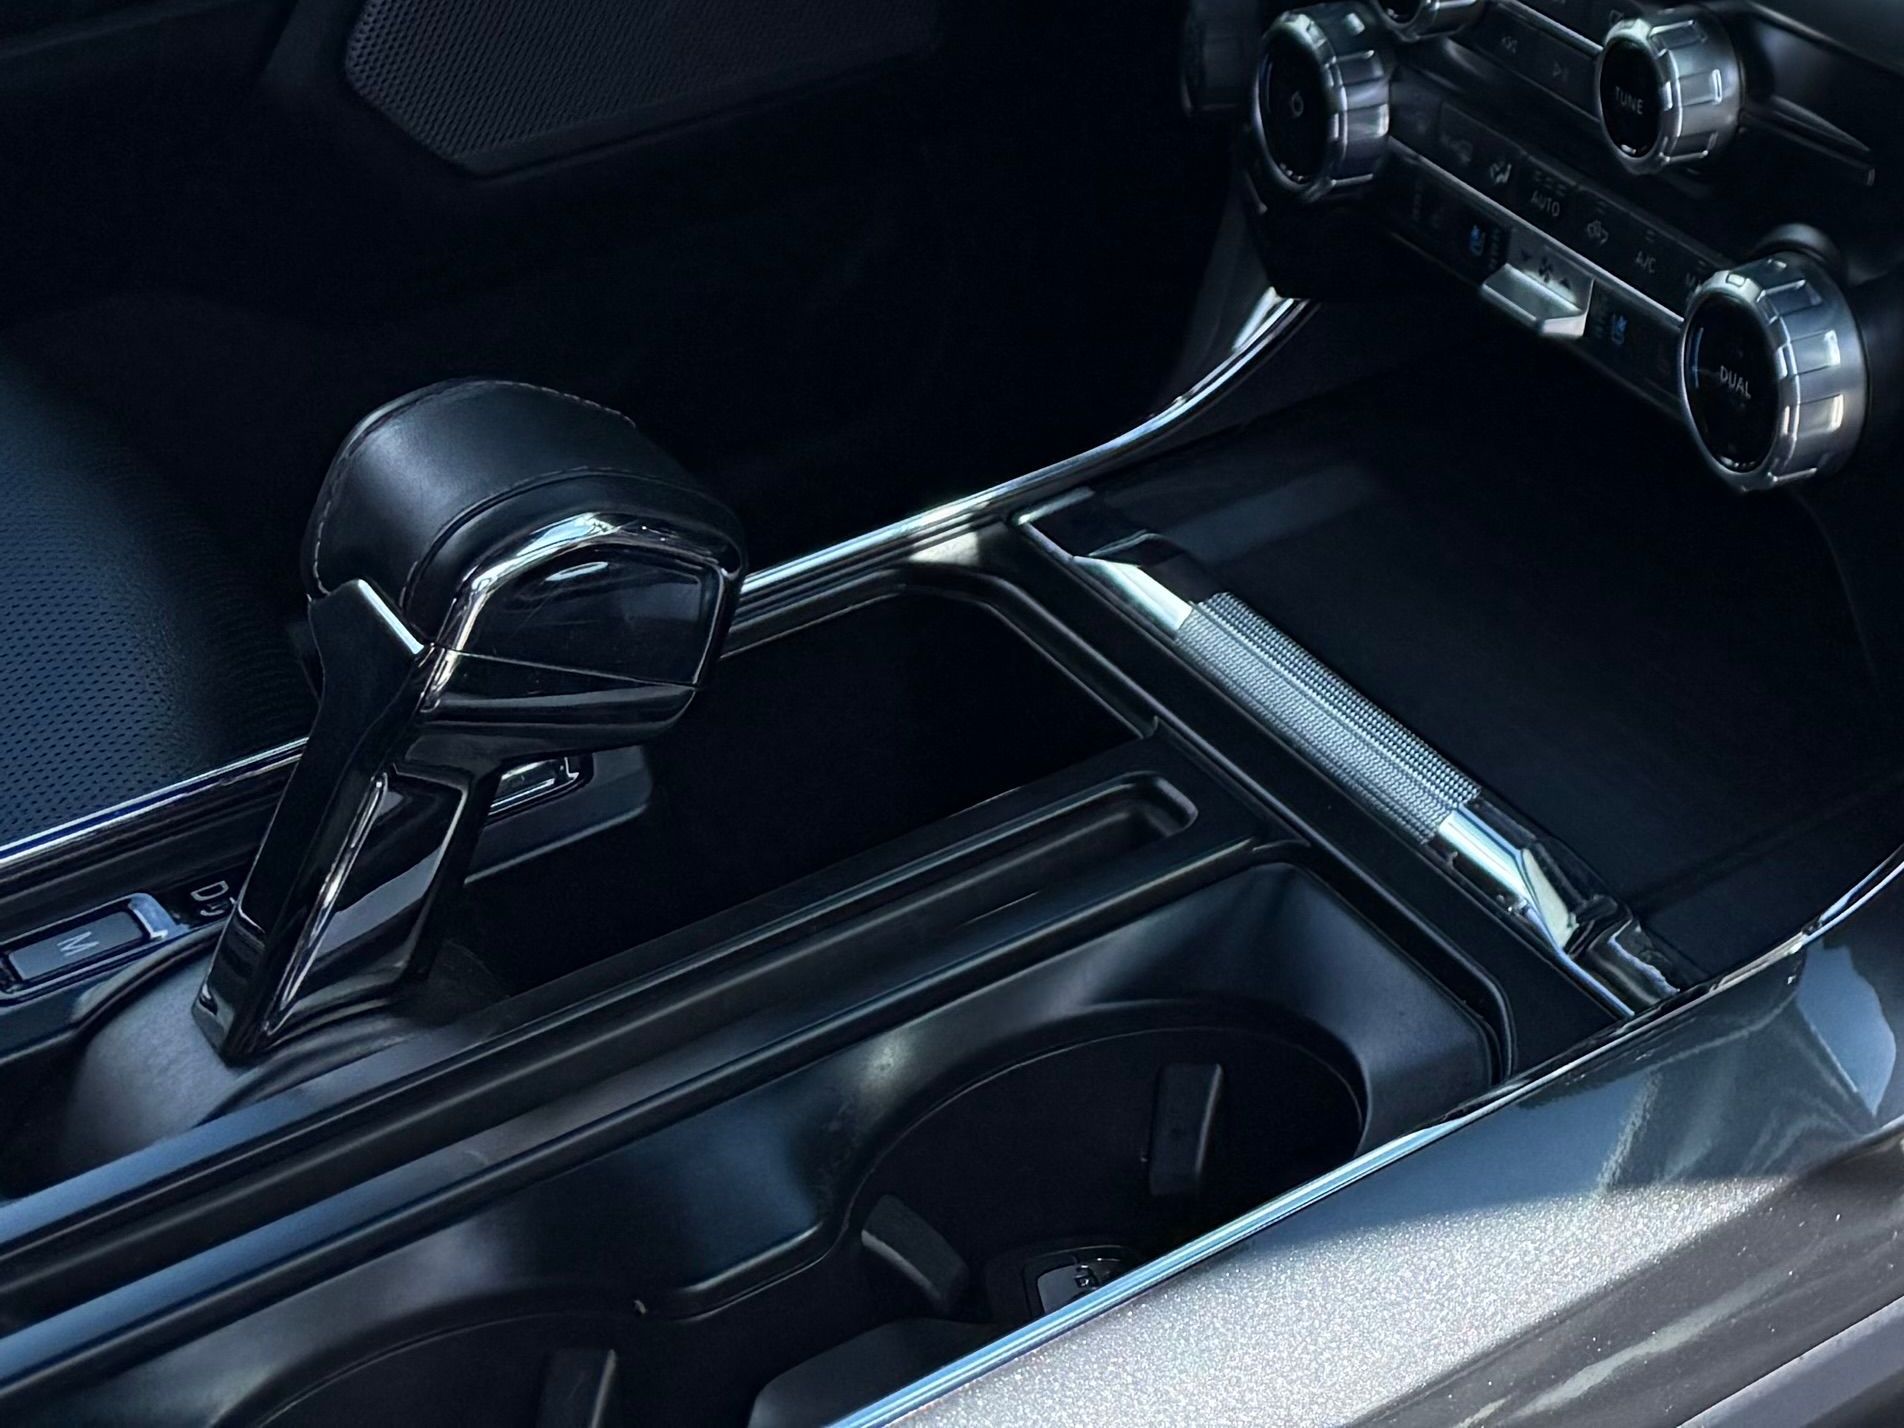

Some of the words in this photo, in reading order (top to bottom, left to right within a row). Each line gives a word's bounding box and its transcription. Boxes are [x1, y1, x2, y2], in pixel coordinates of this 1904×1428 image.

[1614, 85, 1645, 116] TUNE
[1530, 190, 1561, 218] AUTO
[1634, 249, 1657, 275] A/C
[1718, 364, 1752, 401] DUAL
[57, 931, 99, 957] M
